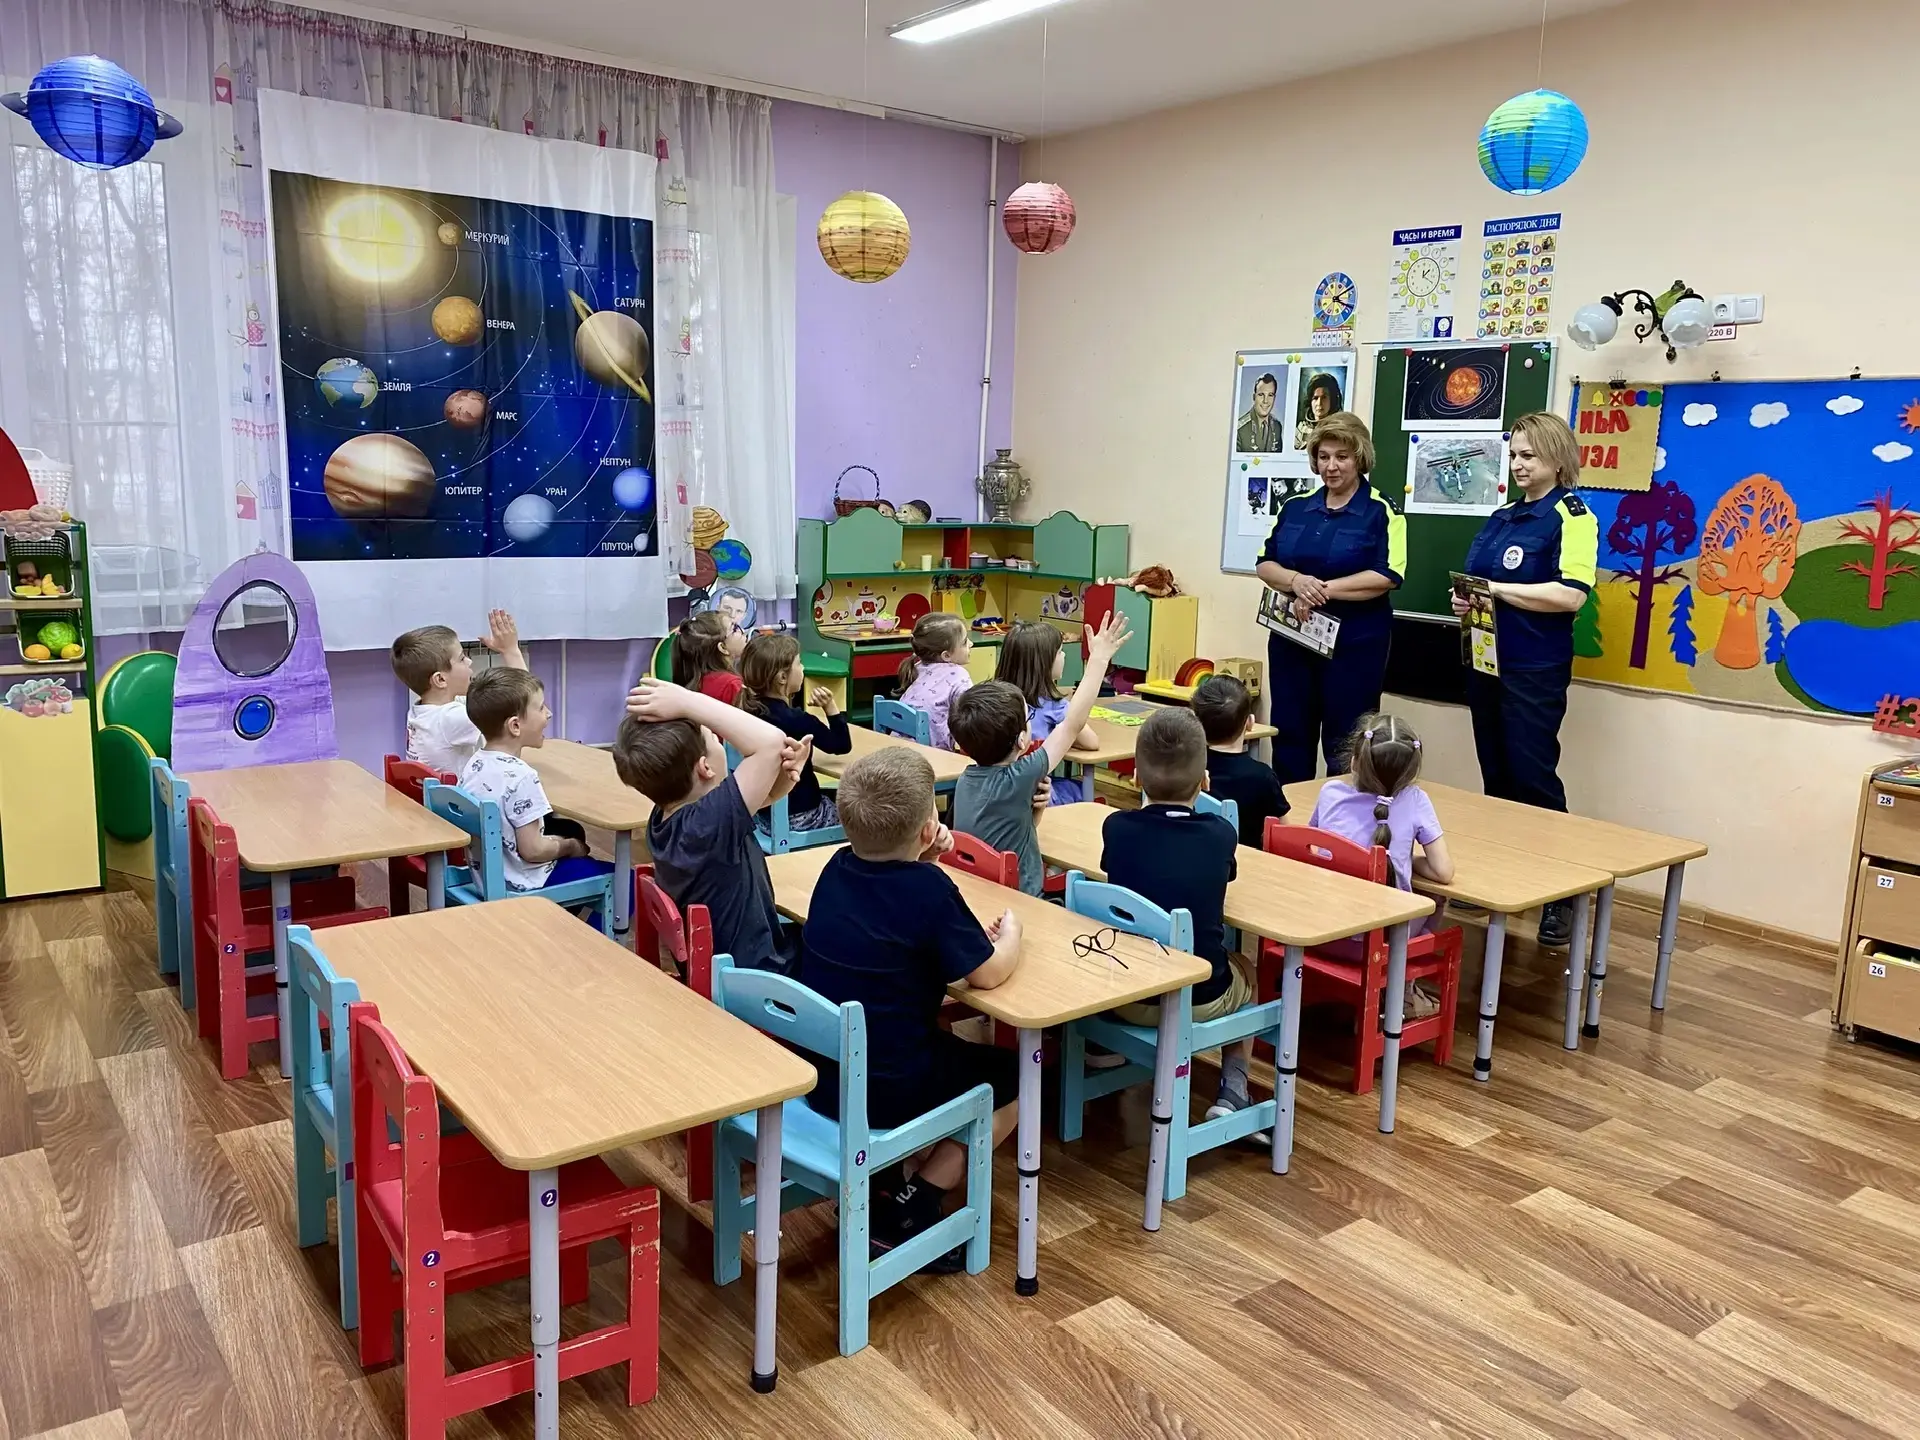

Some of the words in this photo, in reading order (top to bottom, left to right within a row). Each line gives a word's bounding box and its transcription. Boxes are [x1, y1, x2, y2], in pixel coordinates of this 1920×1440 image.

[1486, 219, 1537, 233] РАСПОРЯДОК
[1539, 217, 1558, 228] ДНЯ
[465, 230, 510, 245] МЕРКУРИЙ
[1399, 232, 1419, 241] ЧАСЫ
[1421, 231, 1427, 239] И
[1428, 229, 1455, 239] ВРЕМЯ
[614, 297, 645, 308] САТУРН
[486, 319, 516, 330] ВЕНЕРА
[1709, 329, 1724, 337] 220
[383, 382, 411, 392] ЗЕМЛЯ
[496, 411, 517, 421] МАРС
[600, 457, 631, 467] НЕПТУН
[445, 486, 482, 495] ЮПИТЕР
[545, 487, 567, 496] УРАН
[601, 542, 633, 551] ПЛУТОН
[1880, 796, 1892, 805] 28
[1880, 878, 1892, 887] 27
[227, 944, 233, 952] 2
[1871, 965, 1883, 975] 26
[1036, 1051, 1041, 1062] 2
[857, 1152, 863, 1164] 2
[546, 1192, 553, 1205] 2
[427, 1253, 435, 1266] 2
